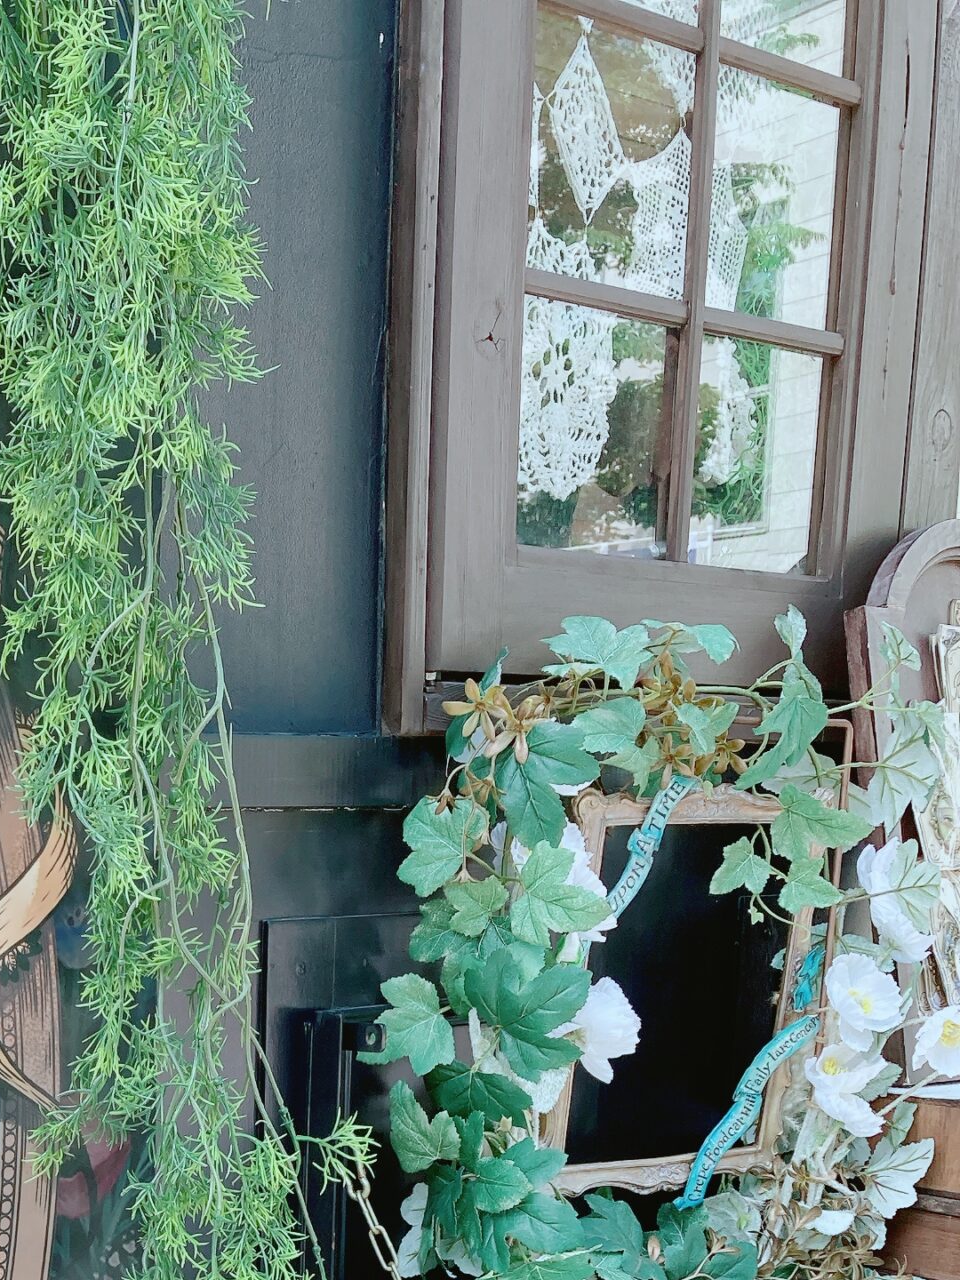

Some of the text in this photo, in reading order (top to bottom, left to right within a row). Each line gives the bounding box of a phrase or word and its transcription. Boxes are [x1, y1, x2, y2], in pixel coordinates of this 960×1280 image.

[607, 781, 686, 911] UPON A TIME
